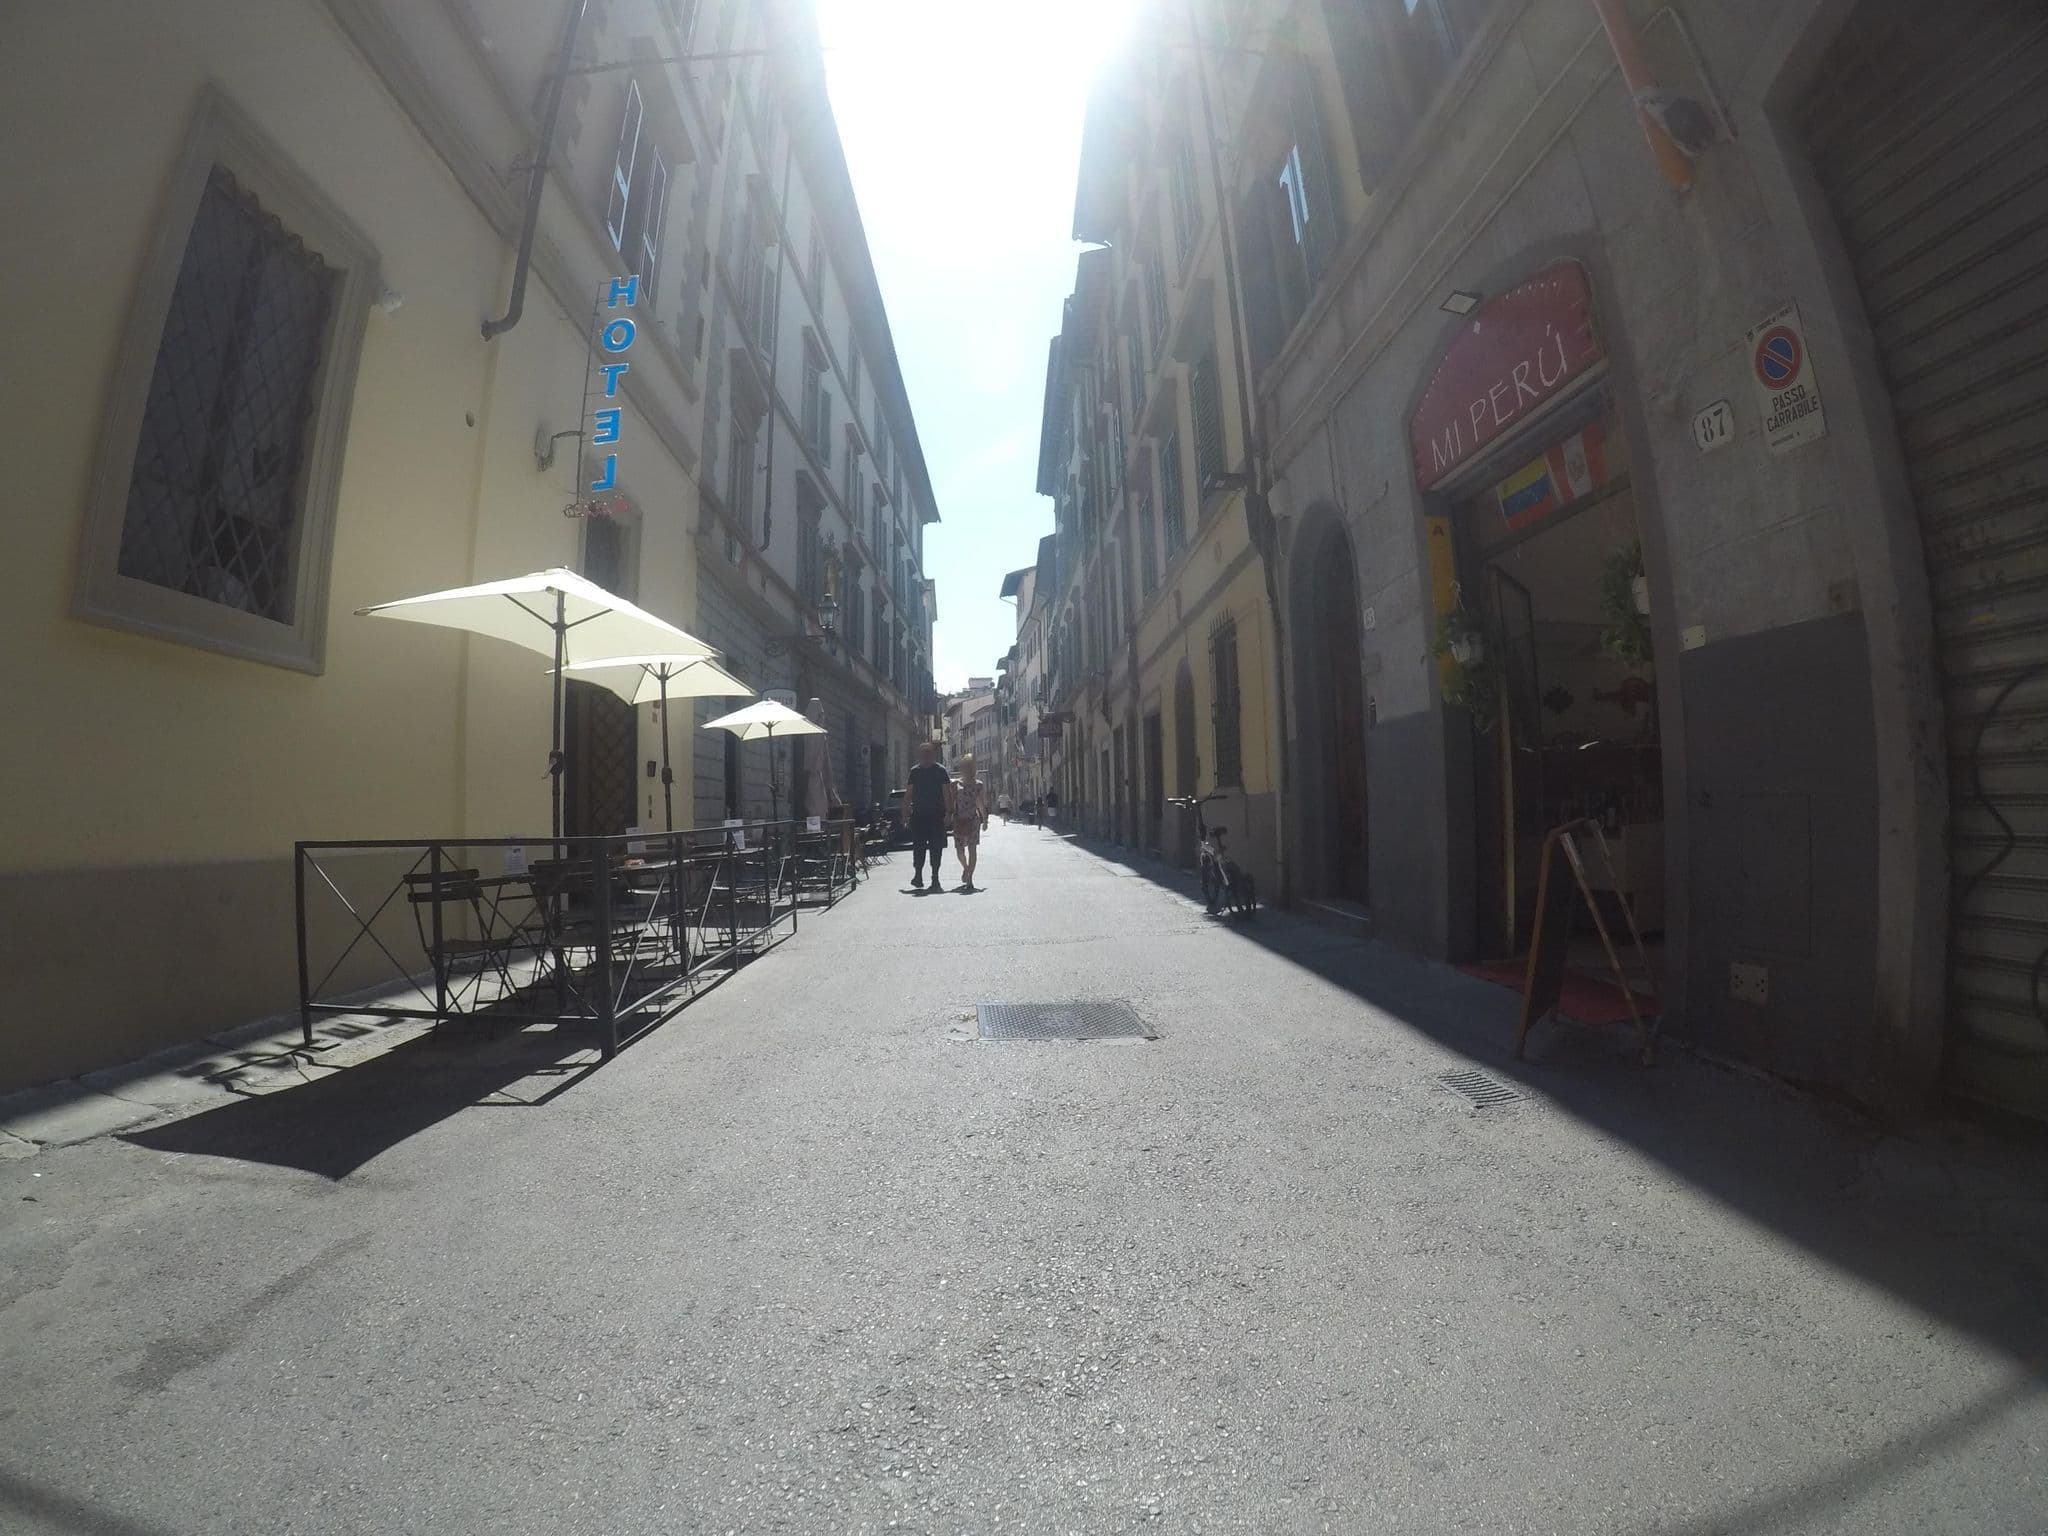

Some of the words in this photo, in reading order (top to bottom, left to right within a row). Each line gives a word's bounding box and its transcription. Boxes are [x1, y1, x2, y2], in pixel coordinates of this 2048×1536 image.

[1431, 420, 1462, 472] MI
[1469, 323, 1568, 442] PERÚ
[1767, 395, 1819, 432] CARRABILE
[1772, 385, 1806, 412] PASSO
[1702, 408, 1725, 442] 87
